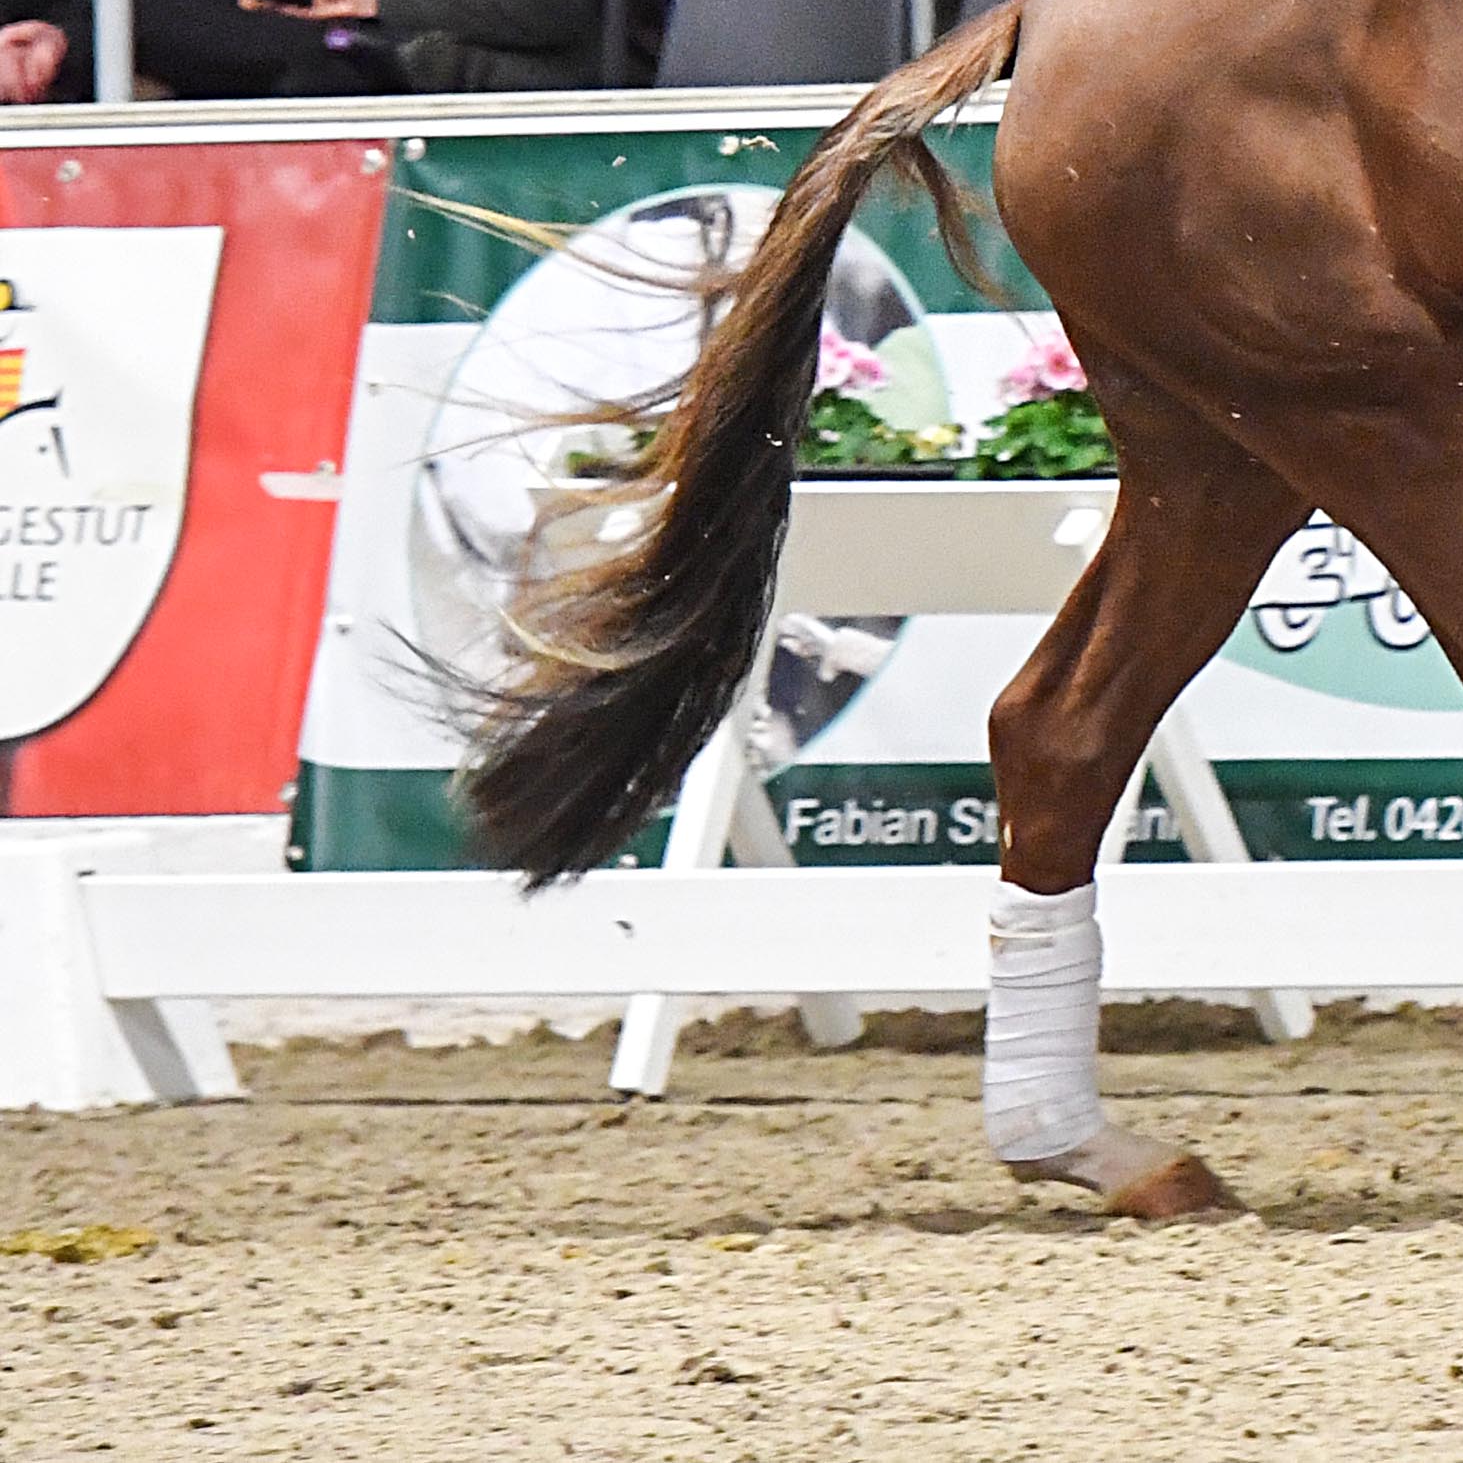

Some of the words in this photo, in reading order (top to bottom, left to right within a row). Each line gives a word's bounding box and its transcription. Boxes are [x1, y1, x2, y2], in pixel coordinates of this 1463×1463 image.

[0, 561, 58, 602] LE
[786, 796, 939, 846] Fabian
[1304, 795, 1377, 842] Tel.
